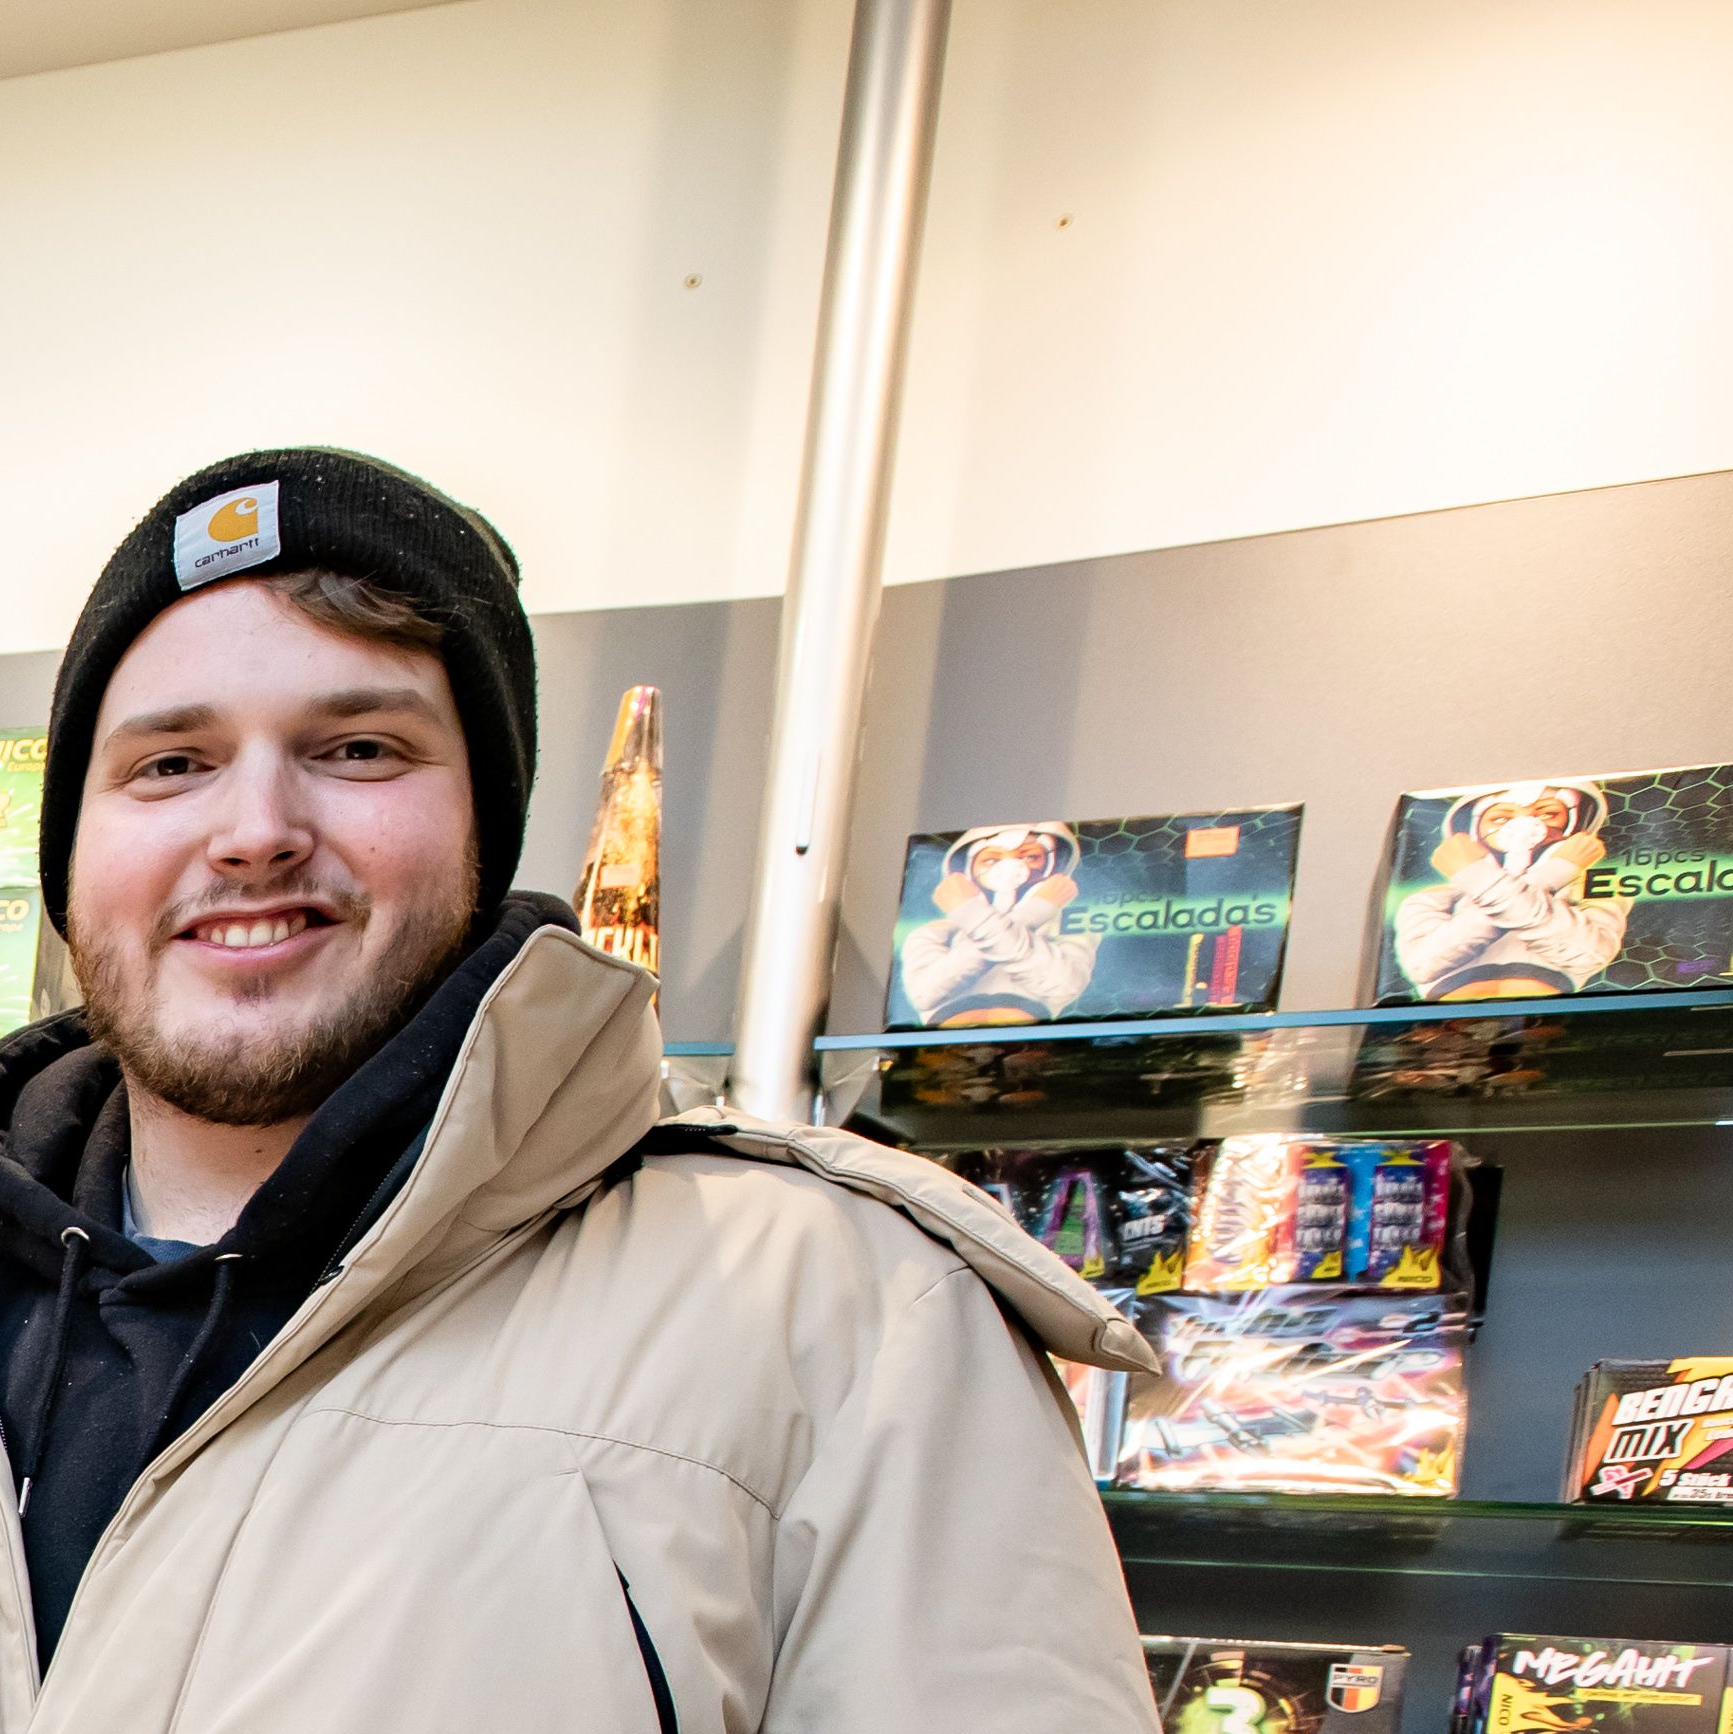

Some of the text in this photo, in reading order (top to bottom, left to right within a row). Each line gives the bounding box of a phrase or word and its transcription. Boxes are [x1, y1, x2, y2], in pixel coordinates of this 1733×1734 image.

[195, 537, 259, 568] carhartt
[1617, 847, 1706, 870] 16pcs
[1610, 1422, 1690, 1459] MIX
[1659, 1469, 1679, 1487] 5
[1333, 1674, 1379, 1687] PYRO
[1513, 1646, 1715, 1688] MEGAHIT
[1498, 1694, 1513, 1727] NICO
